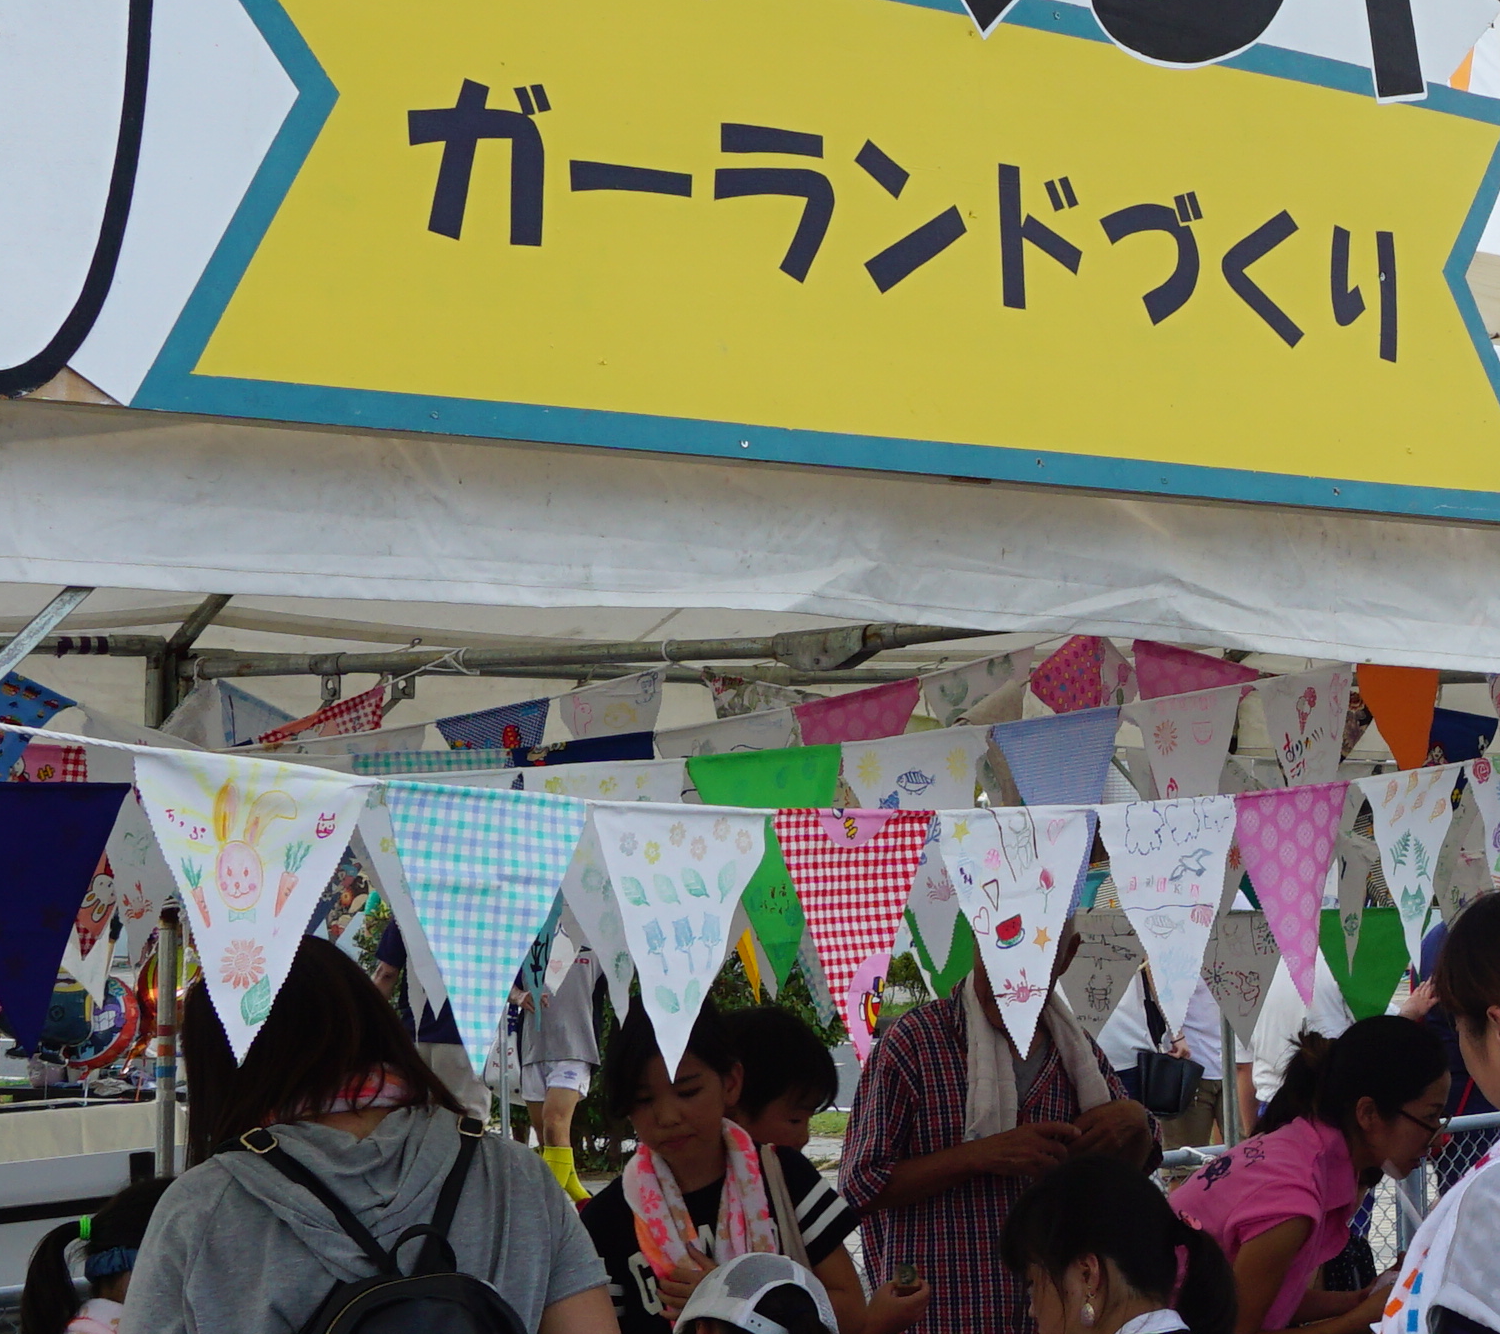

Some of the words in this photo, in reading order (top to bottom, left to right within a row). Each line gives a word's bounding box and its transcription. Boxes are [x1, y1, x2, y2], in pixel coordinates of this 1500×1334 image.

[407, 79, 1400, 364] ガーランドづくり
